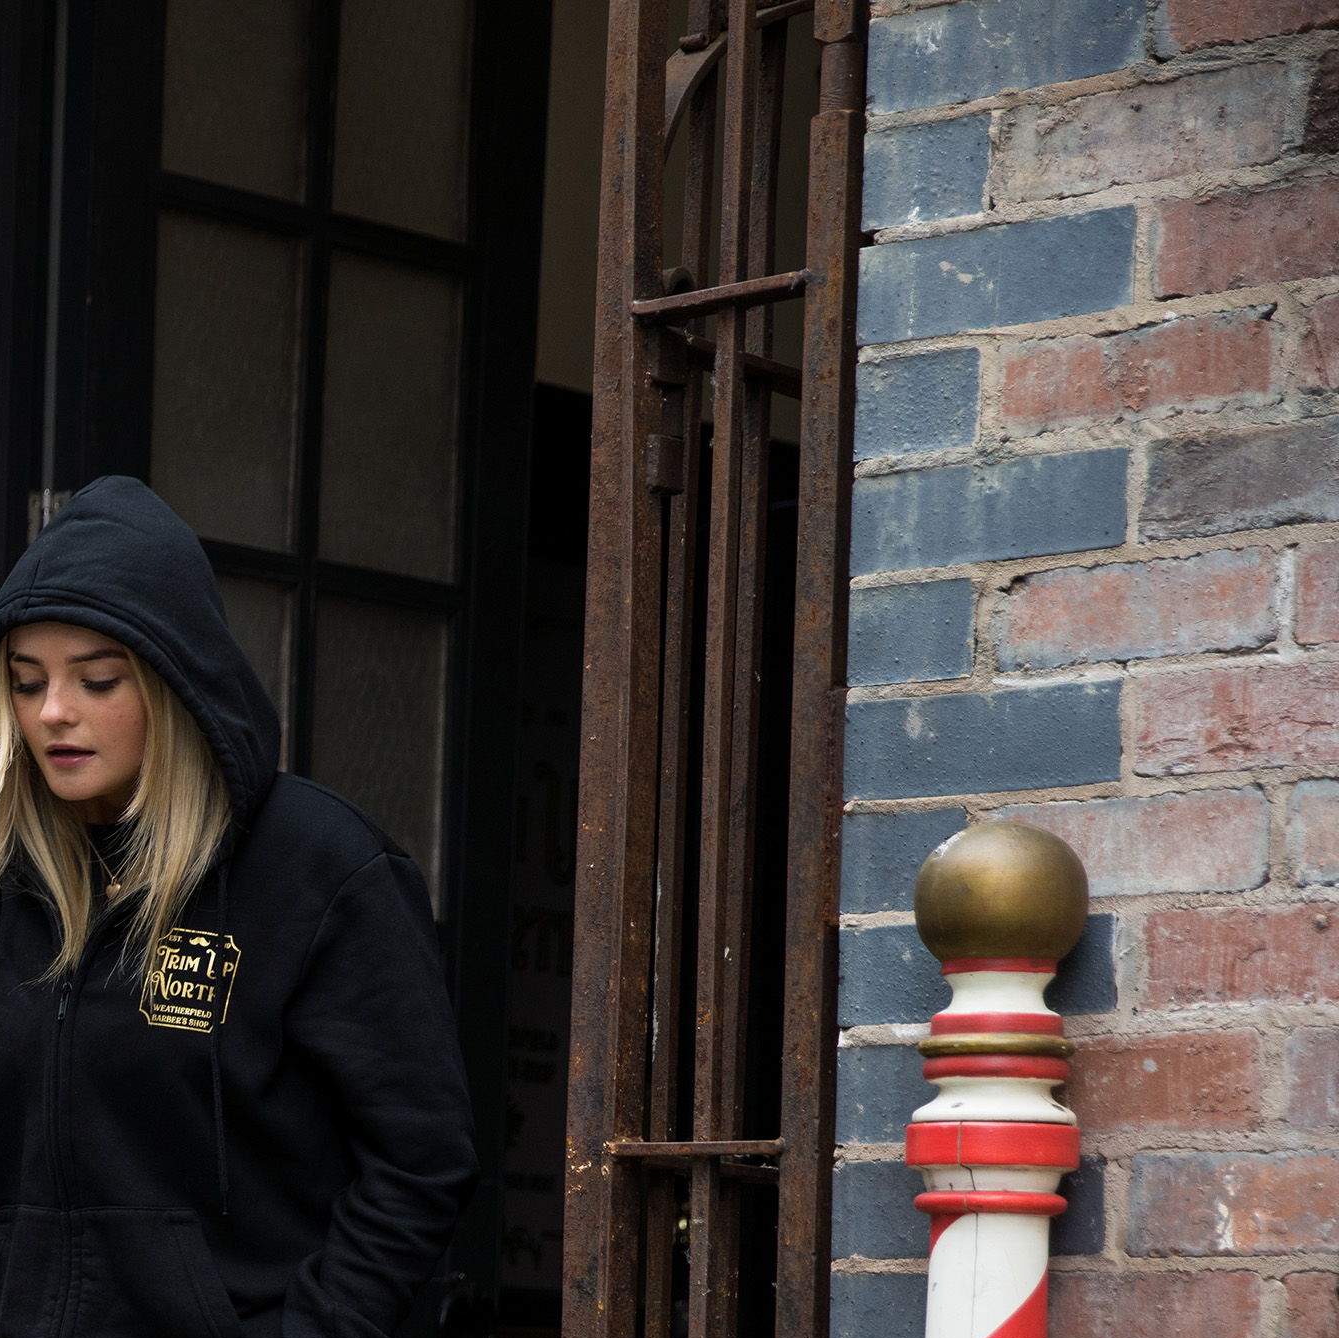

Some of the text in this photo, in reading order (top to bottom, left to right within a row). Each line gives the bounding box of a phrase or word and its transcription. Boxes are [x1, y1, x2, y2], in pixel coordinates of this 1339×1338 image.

[157, 945, 201, 974] TRIM
[153, 1004, 212, 1018] WEATHERFIELD
[189, 1018, 209, 1028] SHOP
